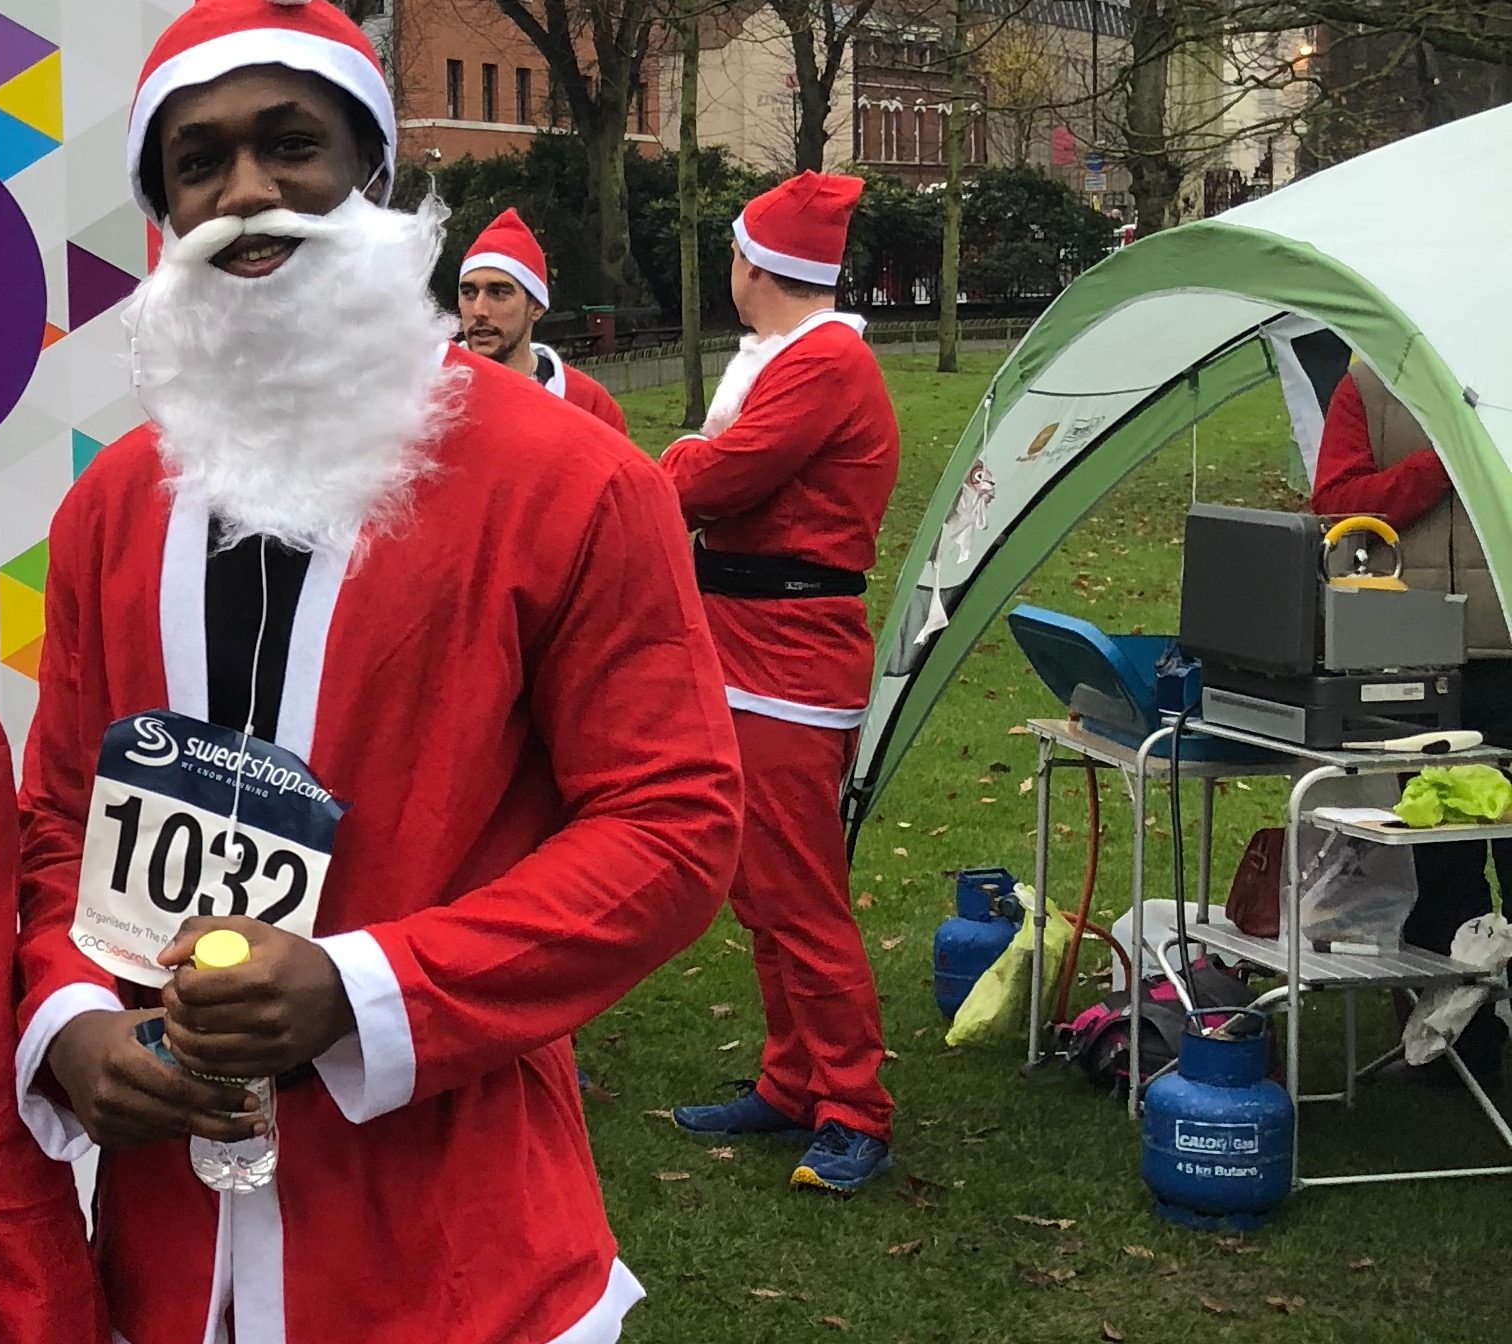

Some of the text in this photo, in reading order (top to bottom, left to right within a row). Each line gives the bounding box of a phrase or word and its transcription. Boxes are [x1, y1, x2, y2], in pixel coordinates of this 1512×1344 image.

[181, 760, 193, 772] WE
[196, 767, 224, 783] KNOW
[184, 737, 332, 803] sweatshop.com
[105, 795, 308, 926] 1032
[86, 906, 131, 932] Organised
[132, 922, 143, 937] by
[145, 927, 160, 943] The
